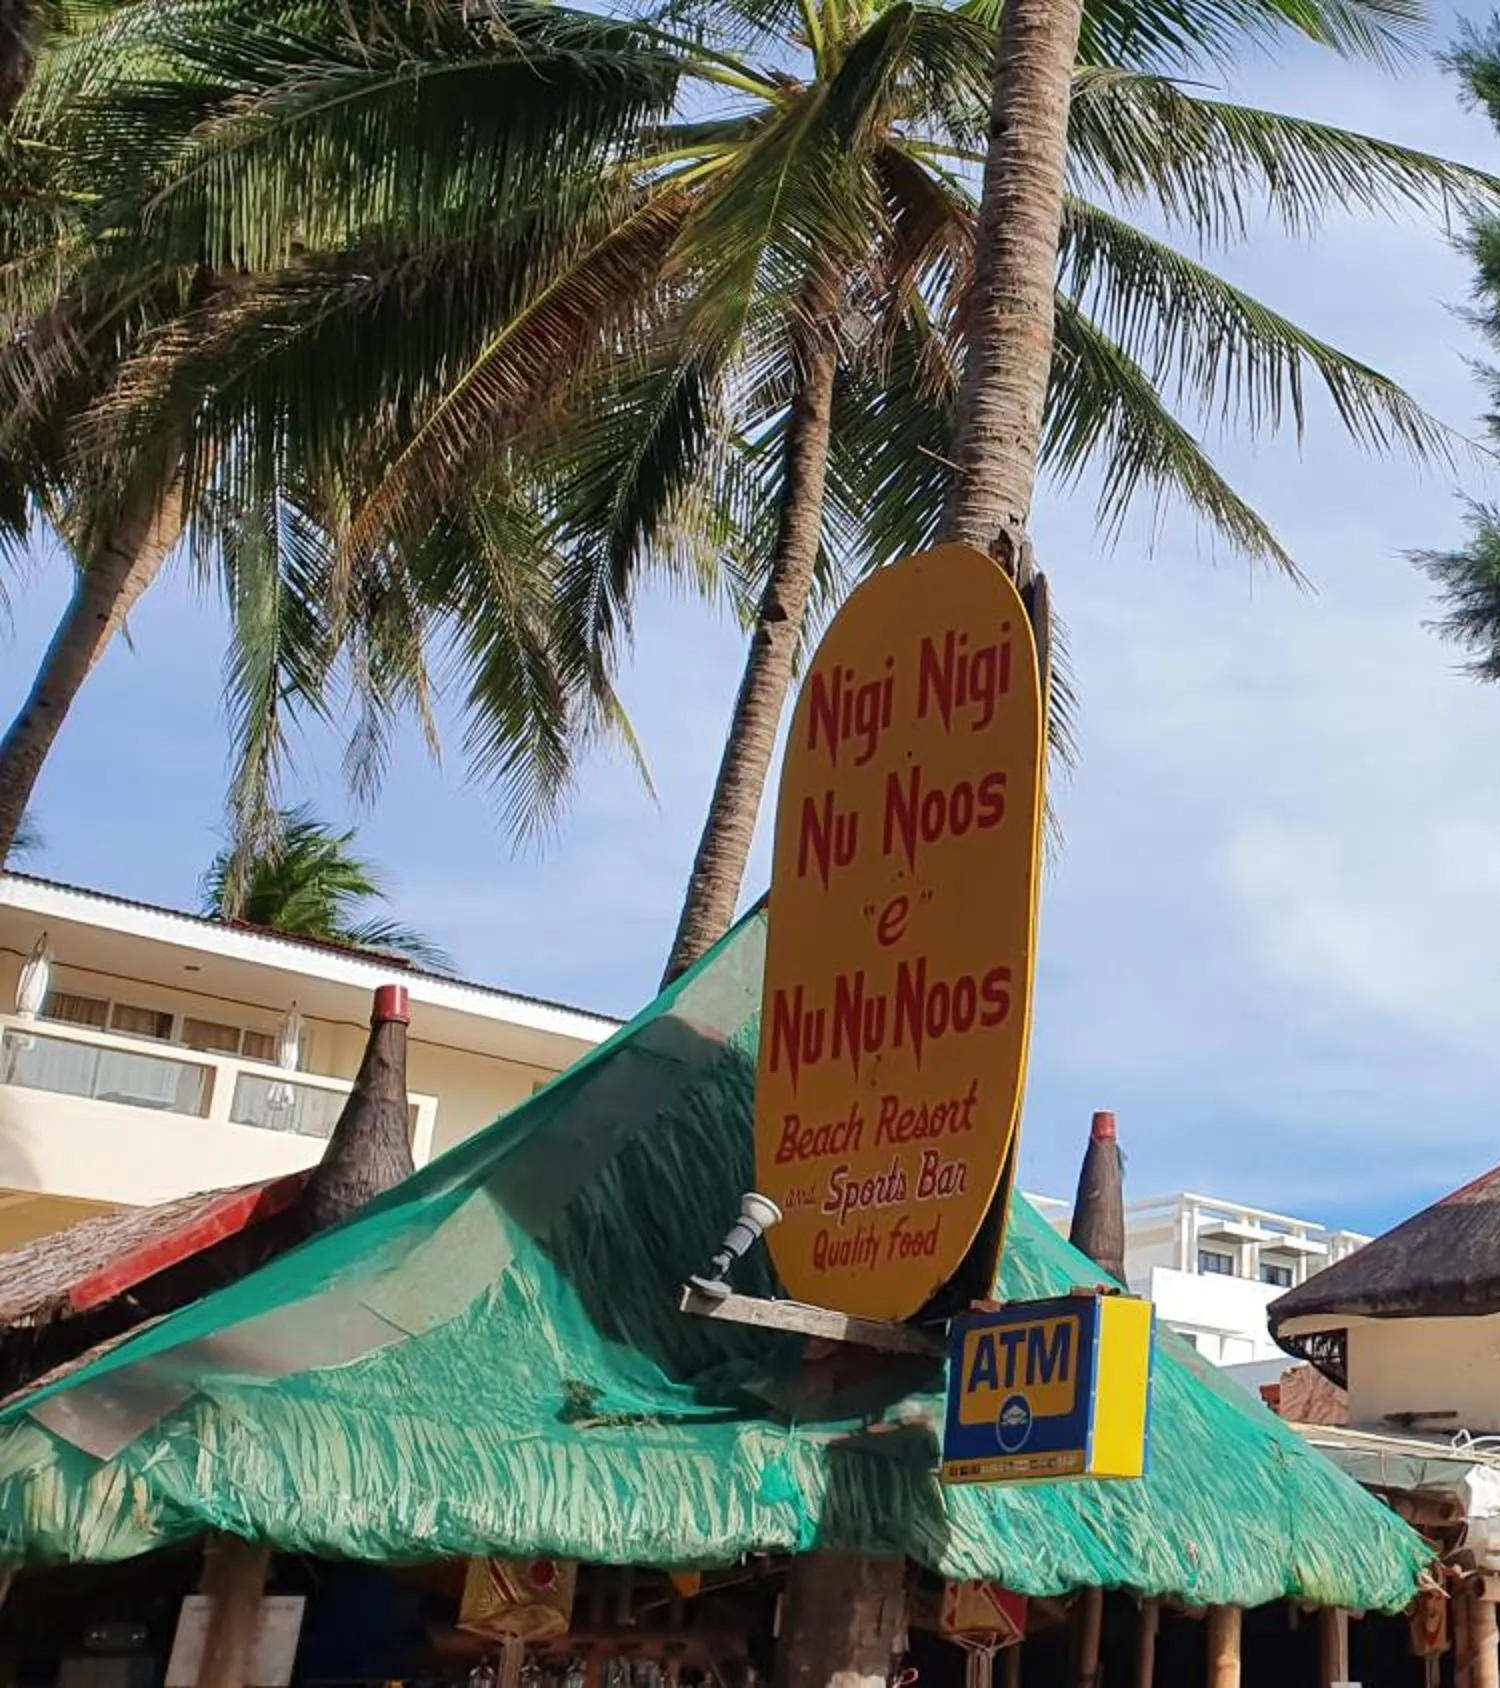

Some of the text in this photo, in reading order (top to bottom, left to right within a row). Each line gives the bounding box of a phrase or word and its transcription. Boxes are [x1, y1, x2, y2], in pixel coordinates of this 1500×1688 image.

[807, 620, 1011, 768] Nigi Nigi
[797, 765, 1006, 894] Nu Noos
[775, 1078, 978, 1164] Beach Resort
[822, 1156, 906, 1225] Sports
[917, 1149, 968, 1198] Bar
[813, 1221, 879, 1271] Quality
[967, 1322, 1072, 1393] ATM
